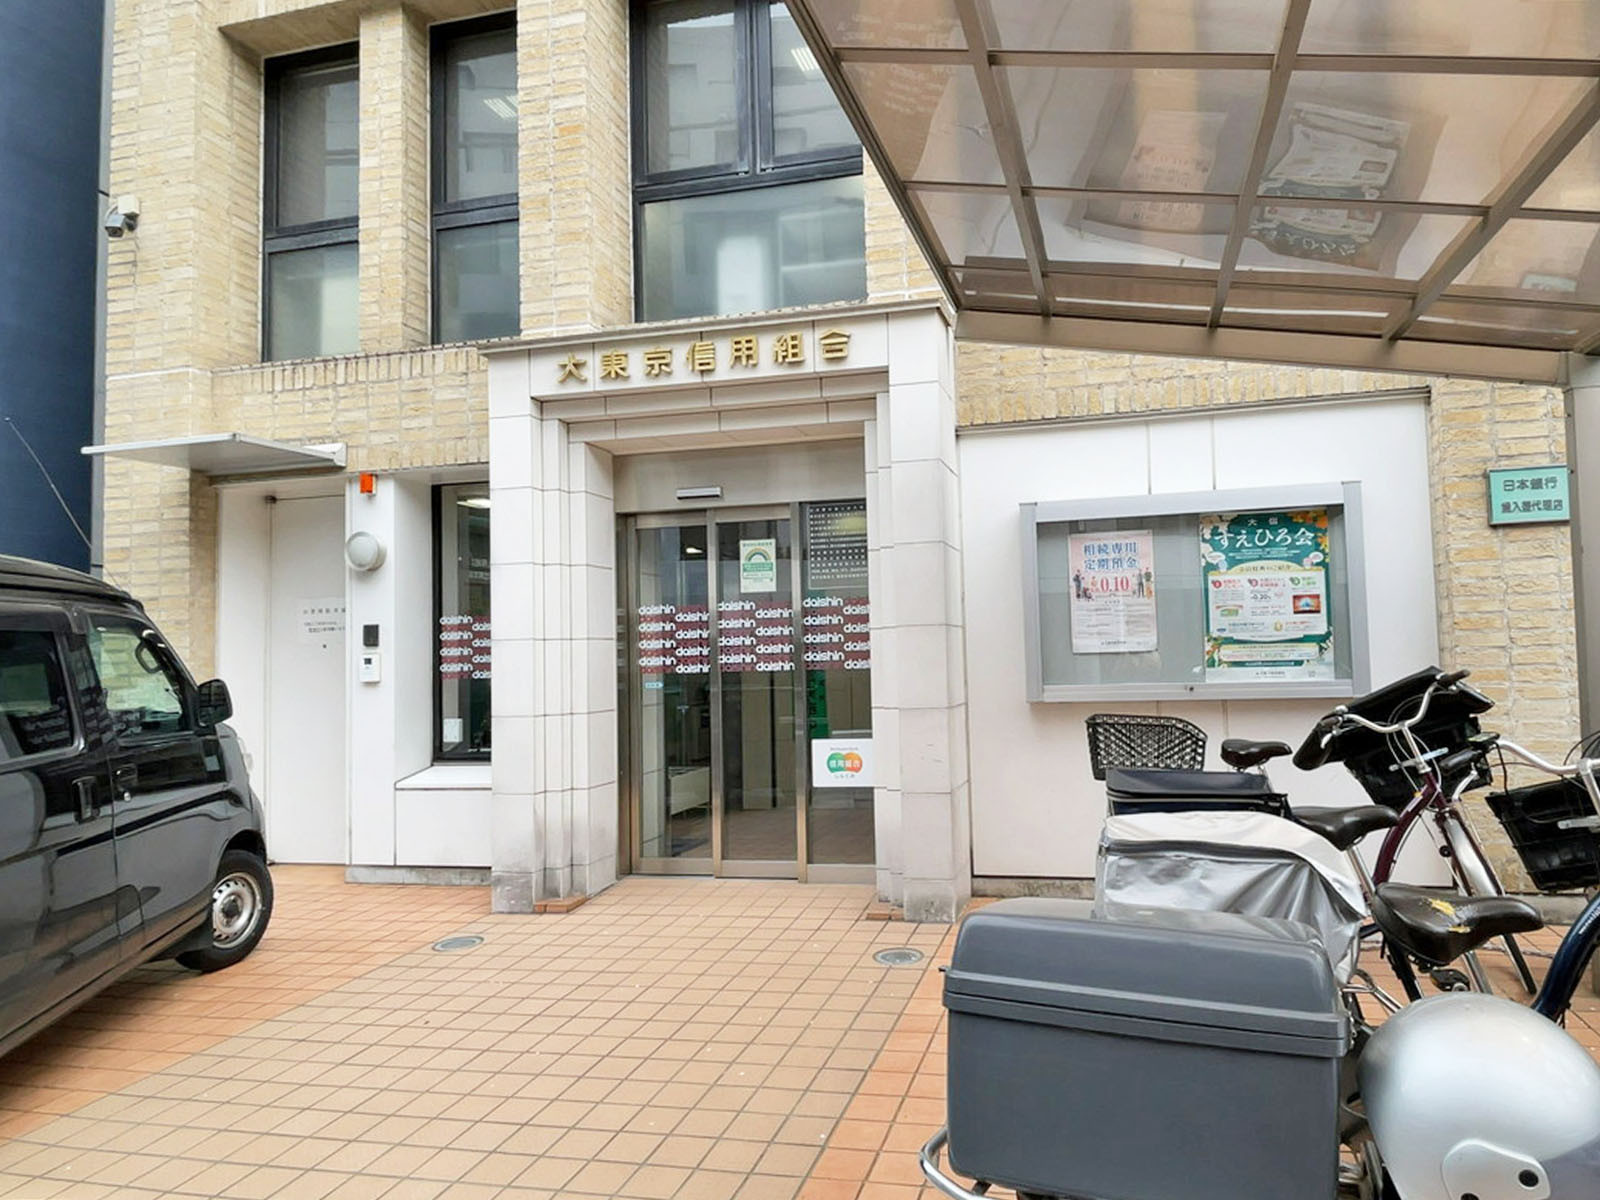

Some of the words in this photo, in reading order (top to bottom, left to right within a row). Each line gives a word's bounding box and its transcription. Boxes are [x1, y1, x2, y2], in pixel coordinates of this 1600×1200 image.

[557, 328, 851, 384] 大東京信用組合
[1503, 476, 1558, 492] 日本銀行
[1214, 527, 1316, 550] すえひろ会
[1083, 542, 1138, 556] 相続専用
[1083, 557, 1139, 571] 定期預金
[717, 600, 755, 611] daishin
[803, 596, 843, 607] daishin
[639, 604, 675, 615] daishin
[755, 608, 794, 618] daishin
[718, 618, 756, 628] daishin
[803, 614, 844, 625] daishin
[639, 621, 676, 632] daishin
[755, 625, 794, 636] daishin
[718, 635, 756, 646] daishin
[804, 632, 844, 643] daishin
[639, 638, 676, 649] daishin
[756, 643, 794, 654] daishin
[639, 655, 676, 666] daishin
[719, 653, 757, 664] daishin
[804, 650, 845, 661] daishin
[756, 661, 795, 671] daishin
